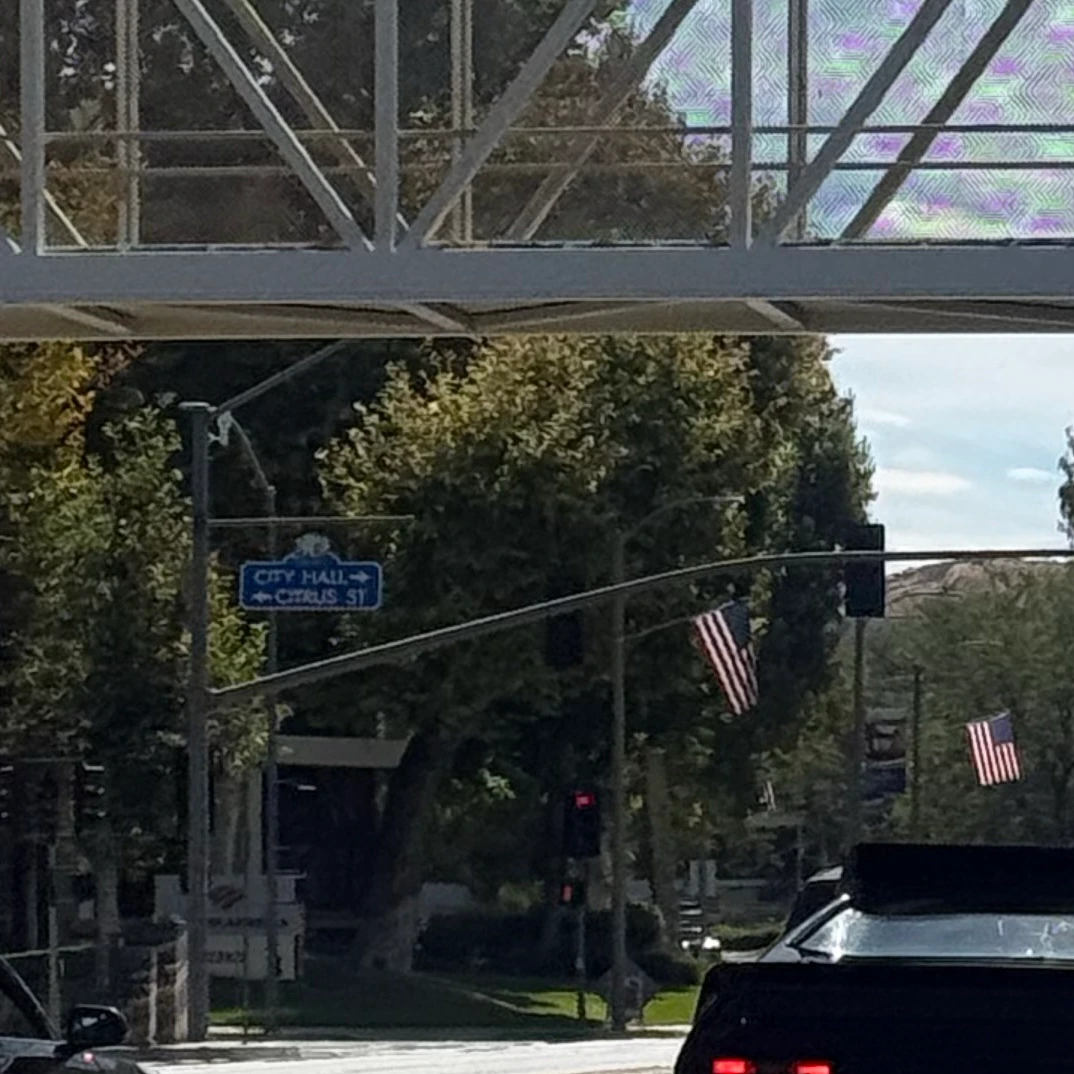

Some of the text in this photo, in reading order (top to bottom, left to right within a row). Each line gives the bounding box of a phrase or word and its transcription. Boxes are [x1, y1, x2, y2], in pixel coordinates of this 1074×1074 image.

[253, 568, 348, 586] CITY HALL
[275, 588, 367, 606] CITRUS ST
